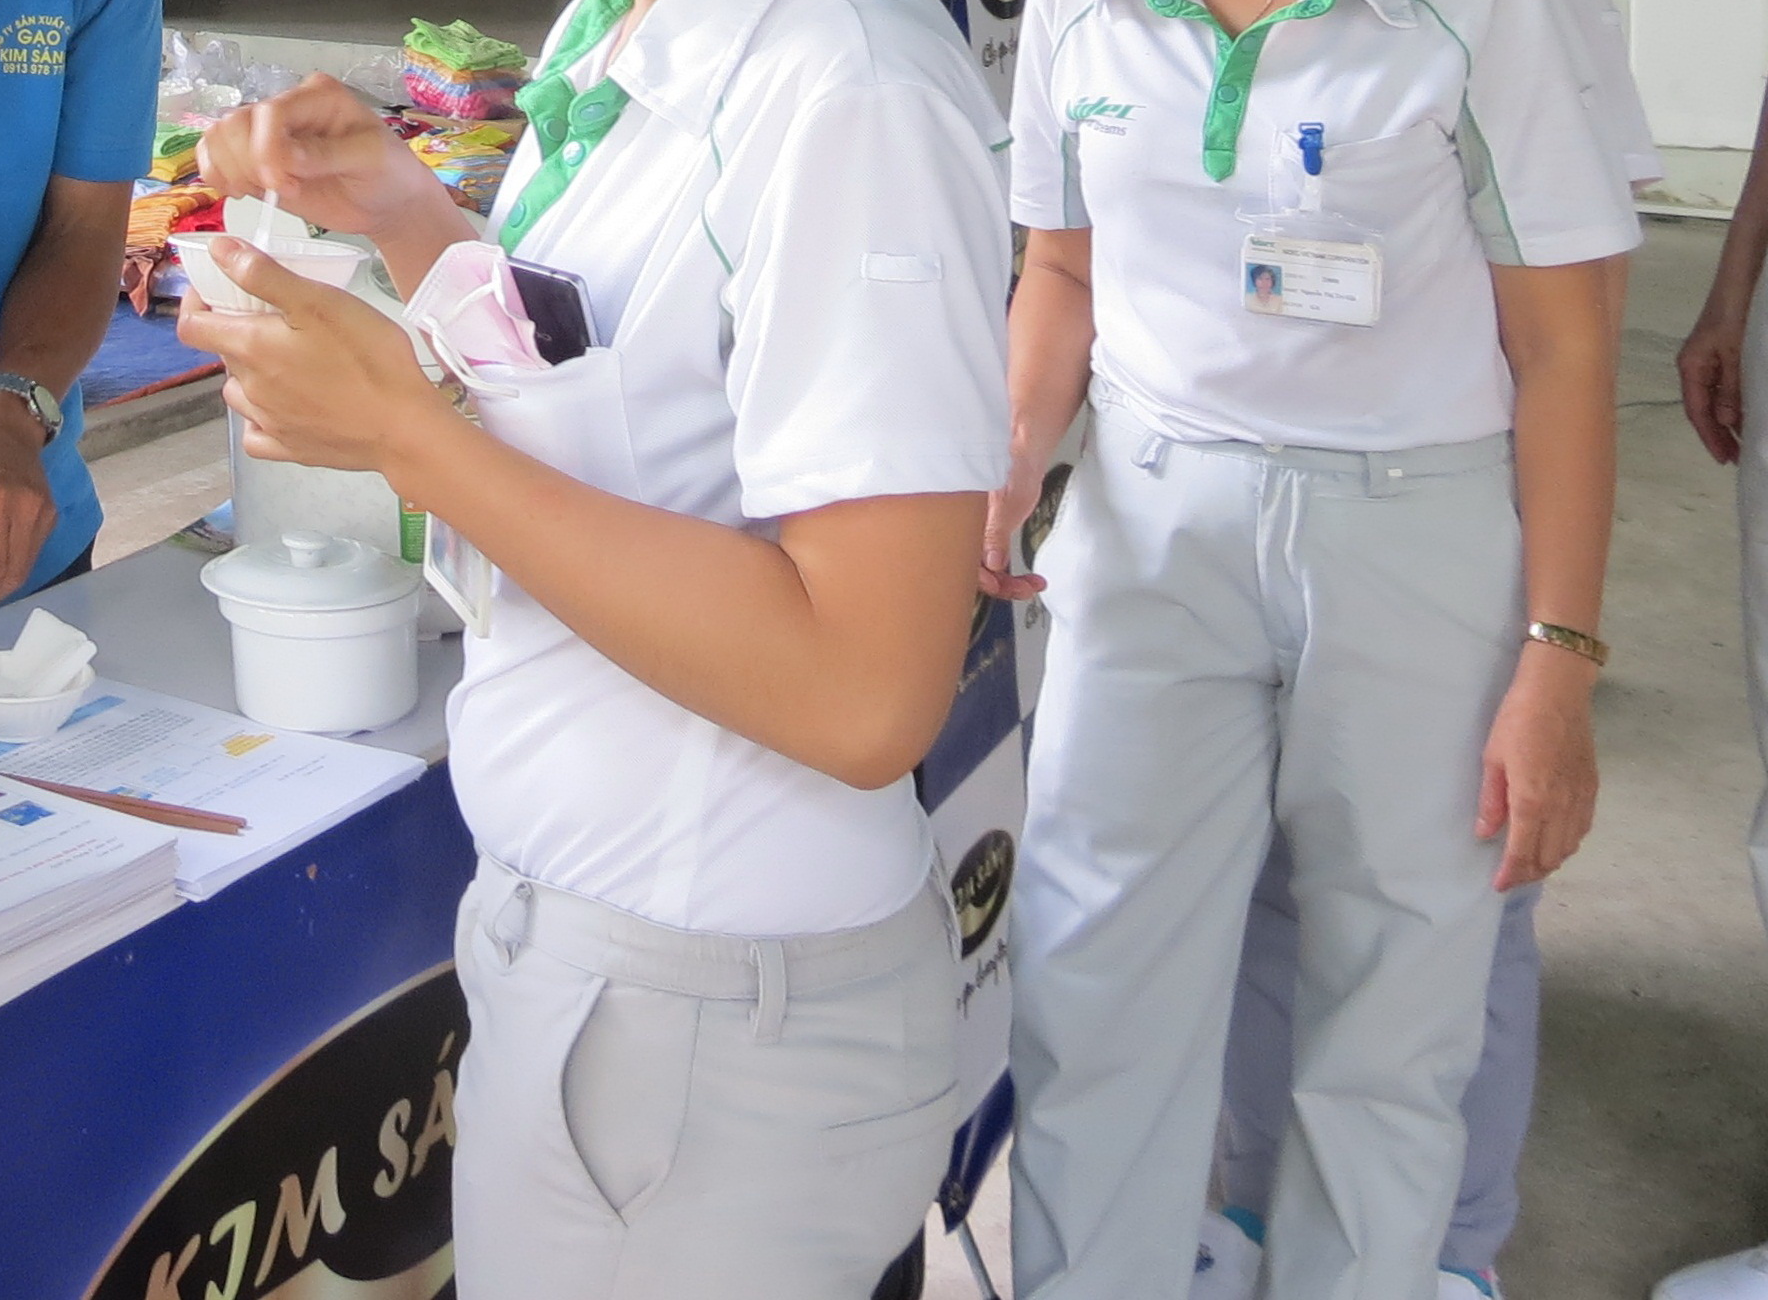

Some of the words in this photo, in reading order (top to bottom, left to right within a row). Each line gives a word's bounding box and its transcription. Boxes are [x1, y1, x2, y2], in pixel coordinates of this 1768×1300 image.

[17, 28, 61, 48] GẠO
[0, 48, 27, 62] KIM
[31, 46, 66, 64] SÁN
[3, 63, 28, 74] 0913
[373, 1030, 456, 1198] SÁ
